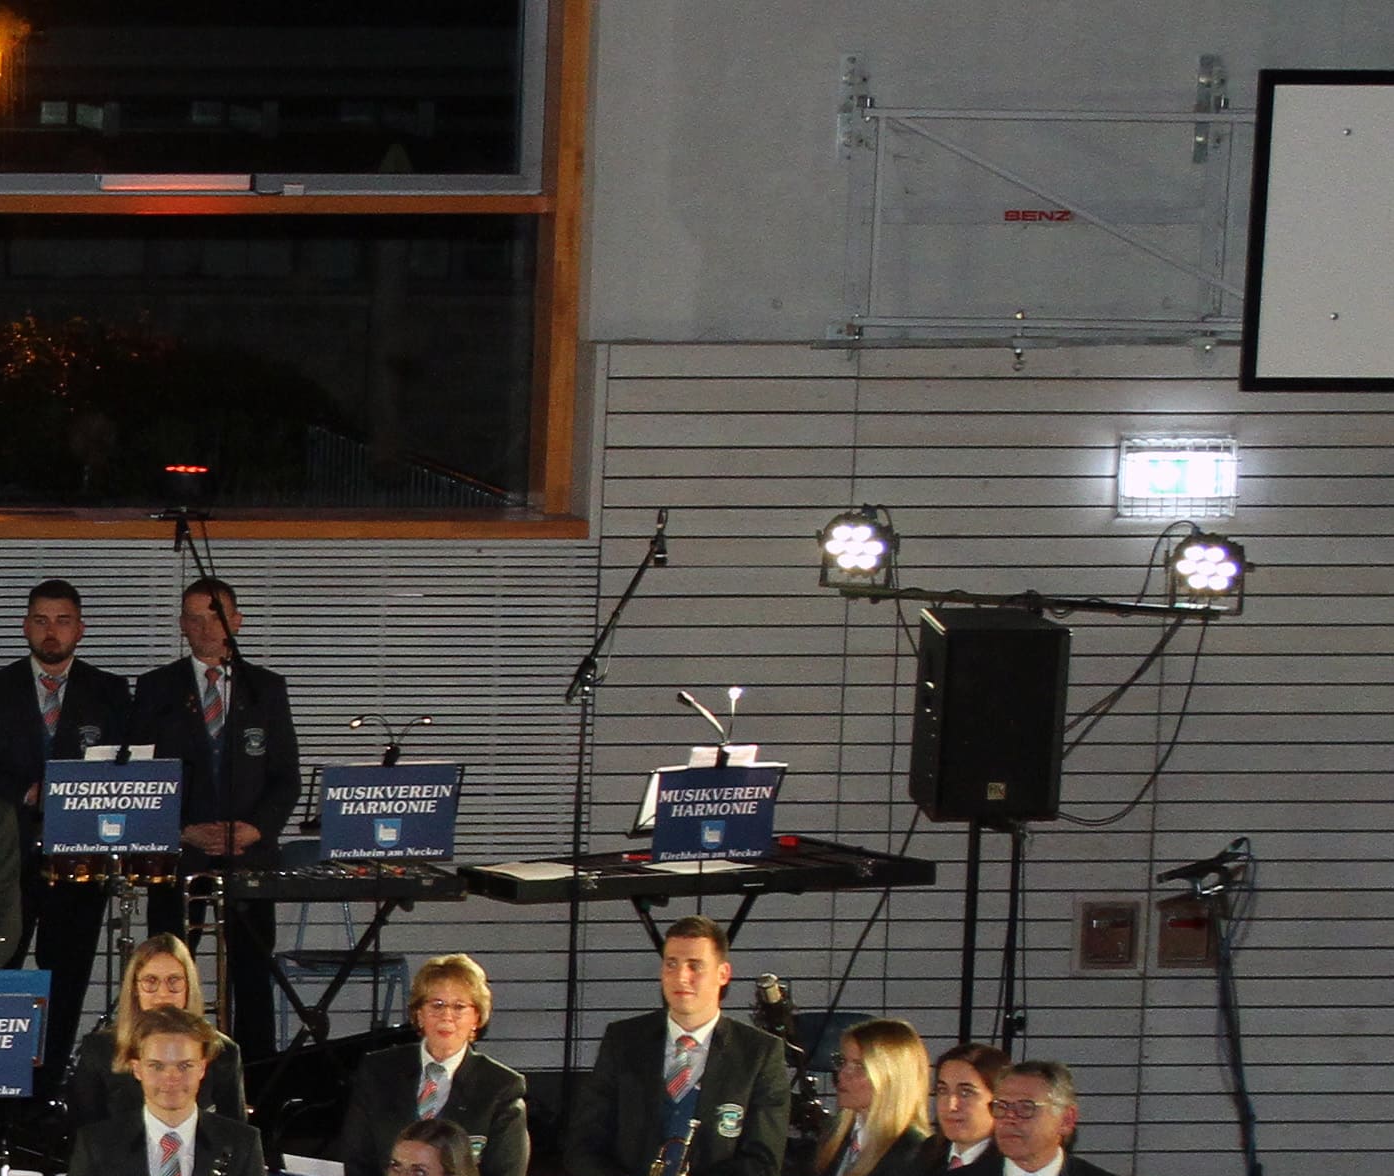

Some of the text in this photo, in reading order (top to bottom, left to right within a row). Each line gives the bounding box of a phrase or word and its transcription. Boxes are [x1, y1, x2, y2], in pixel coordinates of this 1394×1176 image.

[1004, 210, 1071, 221] BENZ
[49, 781, 178, 796] MUSIKVEREIN
[326, 784, 453, 800] MUSIKVEREIN
[660, 786, 773, 803] MUSIKVEREIN
[64, 796, 162, 810] HARMONIE
[341, 800, 437, 815] HARMONIE
[671, 801, 758, 817] HARMONIE
[53, 843, 108, 852] Kirchheim
[129, 843, 169, 852] Neckar
[330, 849, 385, 858] Kirchheim
[406, 848, 444, 857] Neckar
[660, 851, 713, 861] Kirchheim
[730, 849, 762, 858] Neckar
